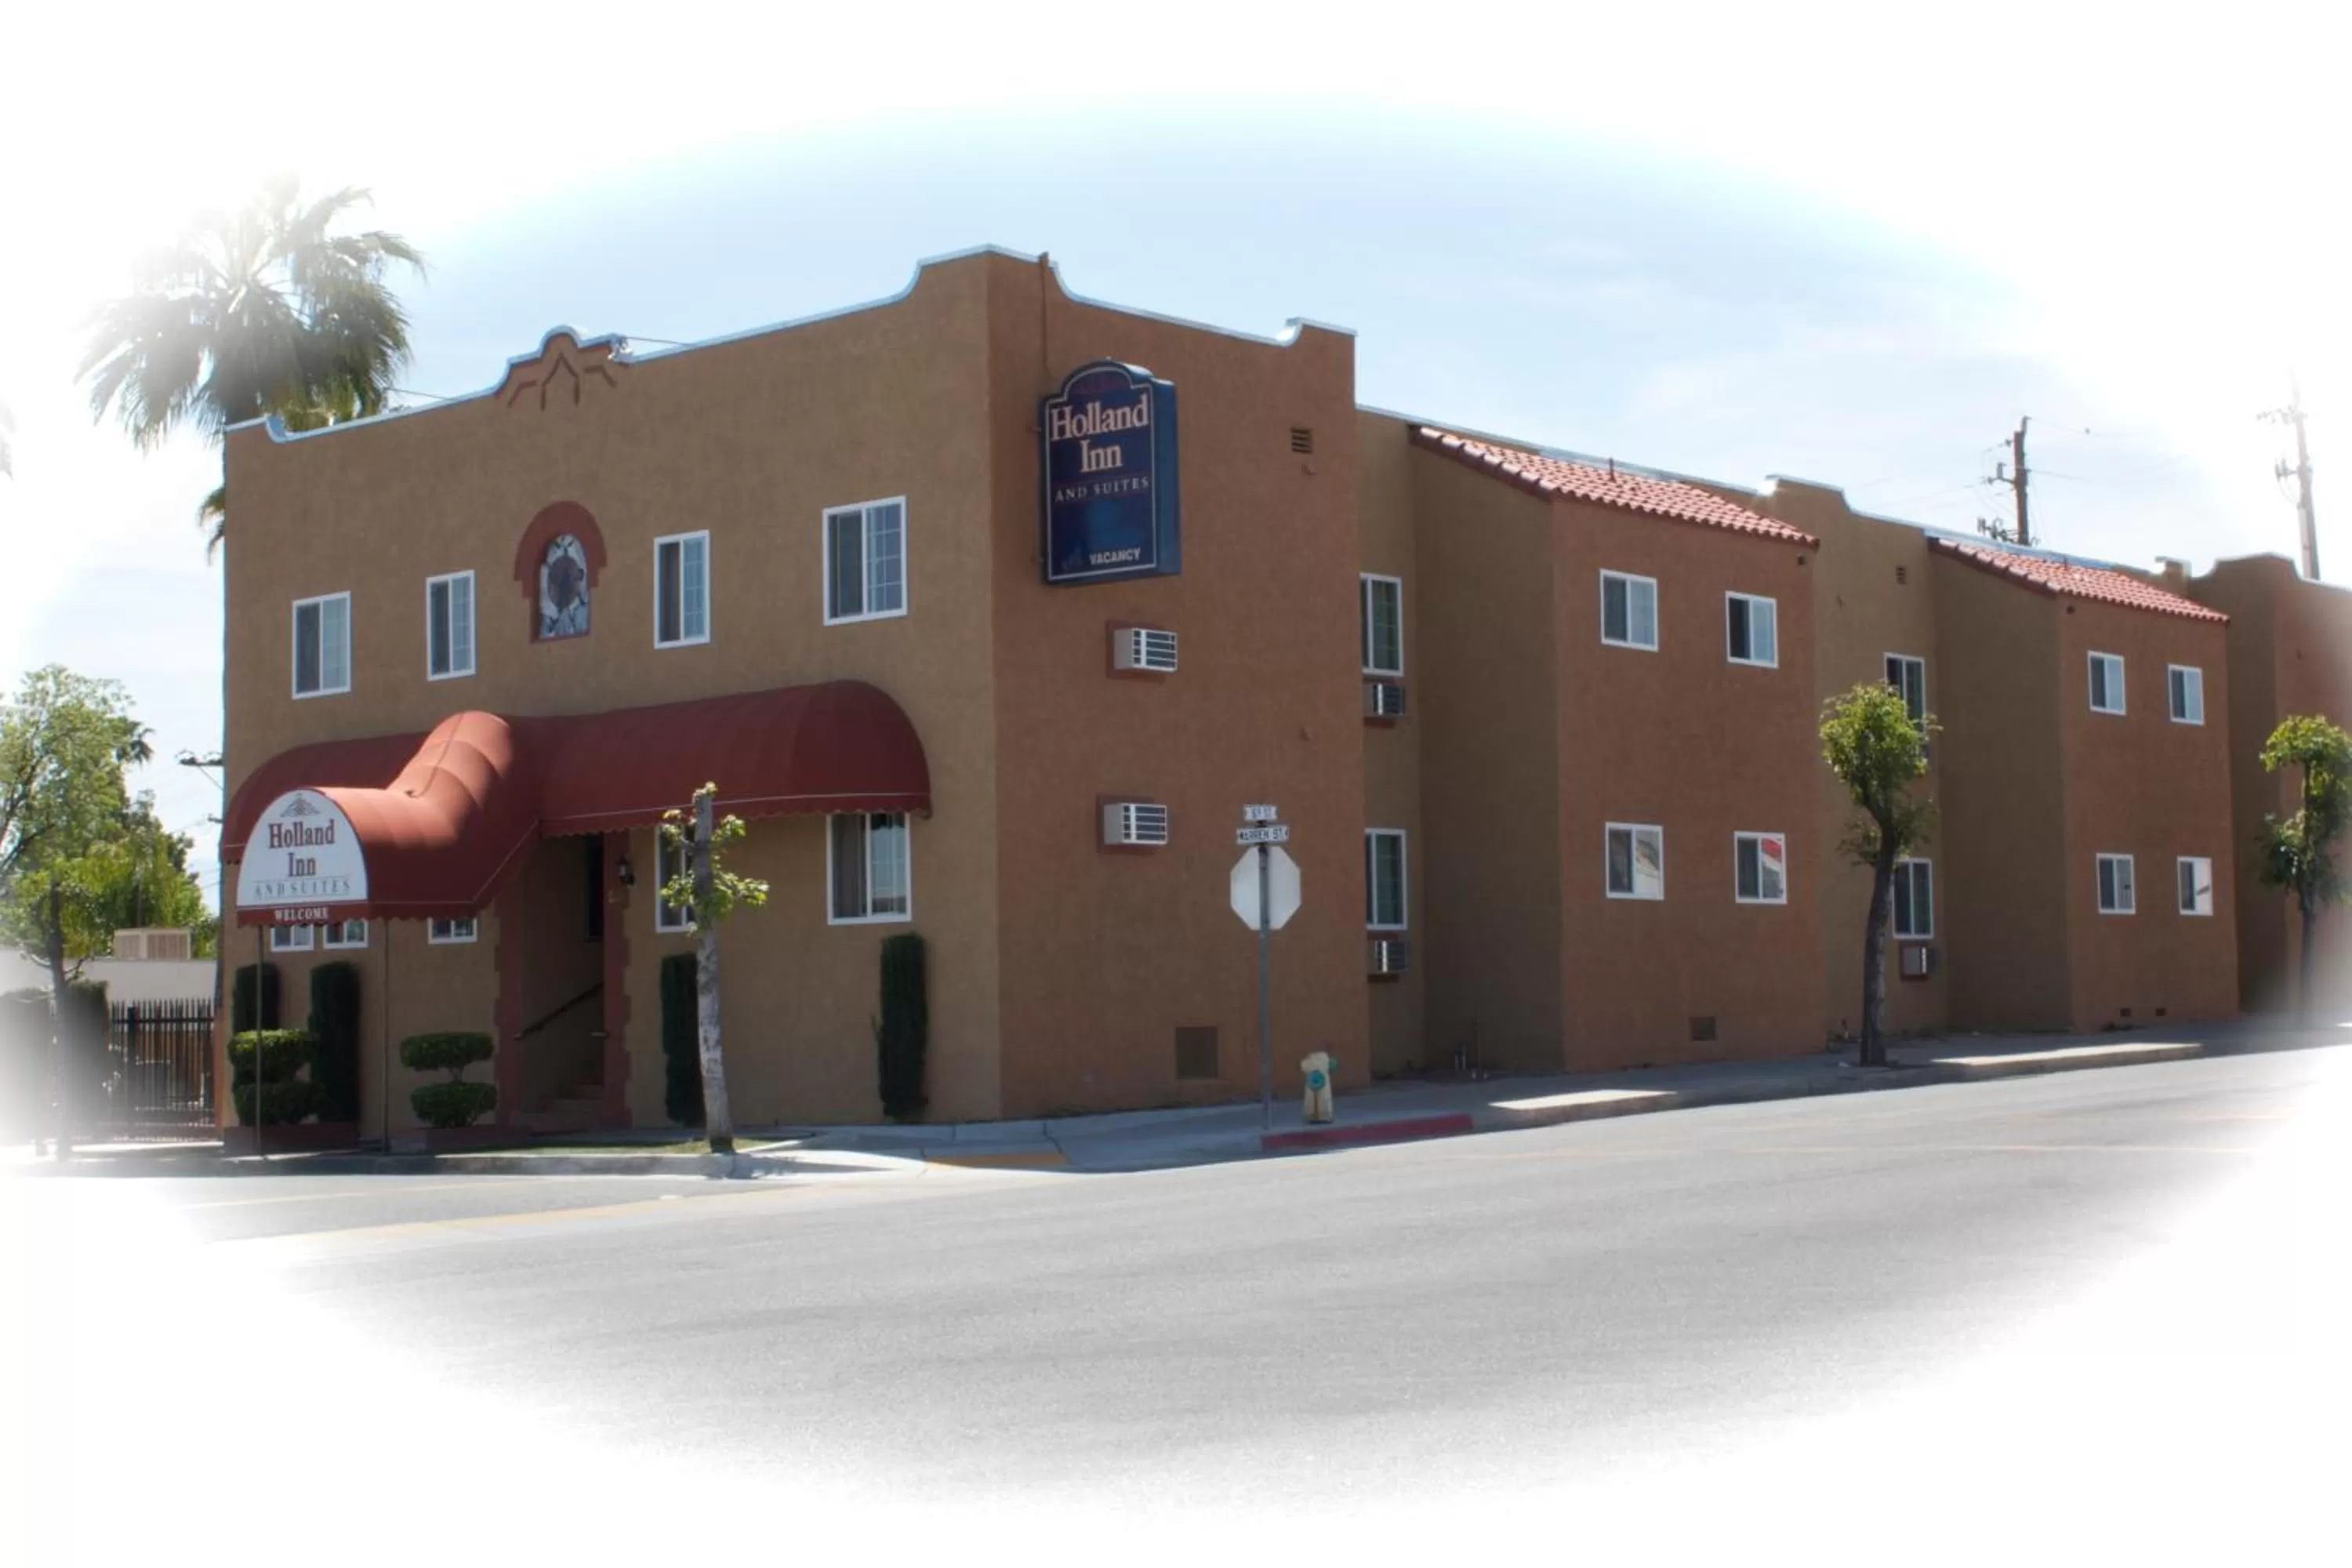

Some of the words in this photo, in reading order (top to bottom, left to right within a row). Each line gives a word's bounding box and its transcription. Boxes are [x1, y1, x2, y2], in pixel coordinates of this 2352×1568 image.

[1051, 394, 1149, 441] Holland
[1079, 439, 1122, 472] Inn
[1054, 486, 1088, 503] AND
[1094, 476, 1149, 496] SUITES
[1089, 547, 1141, 565] VACANCY
[269, 818, 335, 848] Holland
[288, 852, 316, 877] Inn
[253, 883, 285, 899] AND
[290, 879, 350, 896] SUITES
[275, 907, 328, 920] WELCOME
